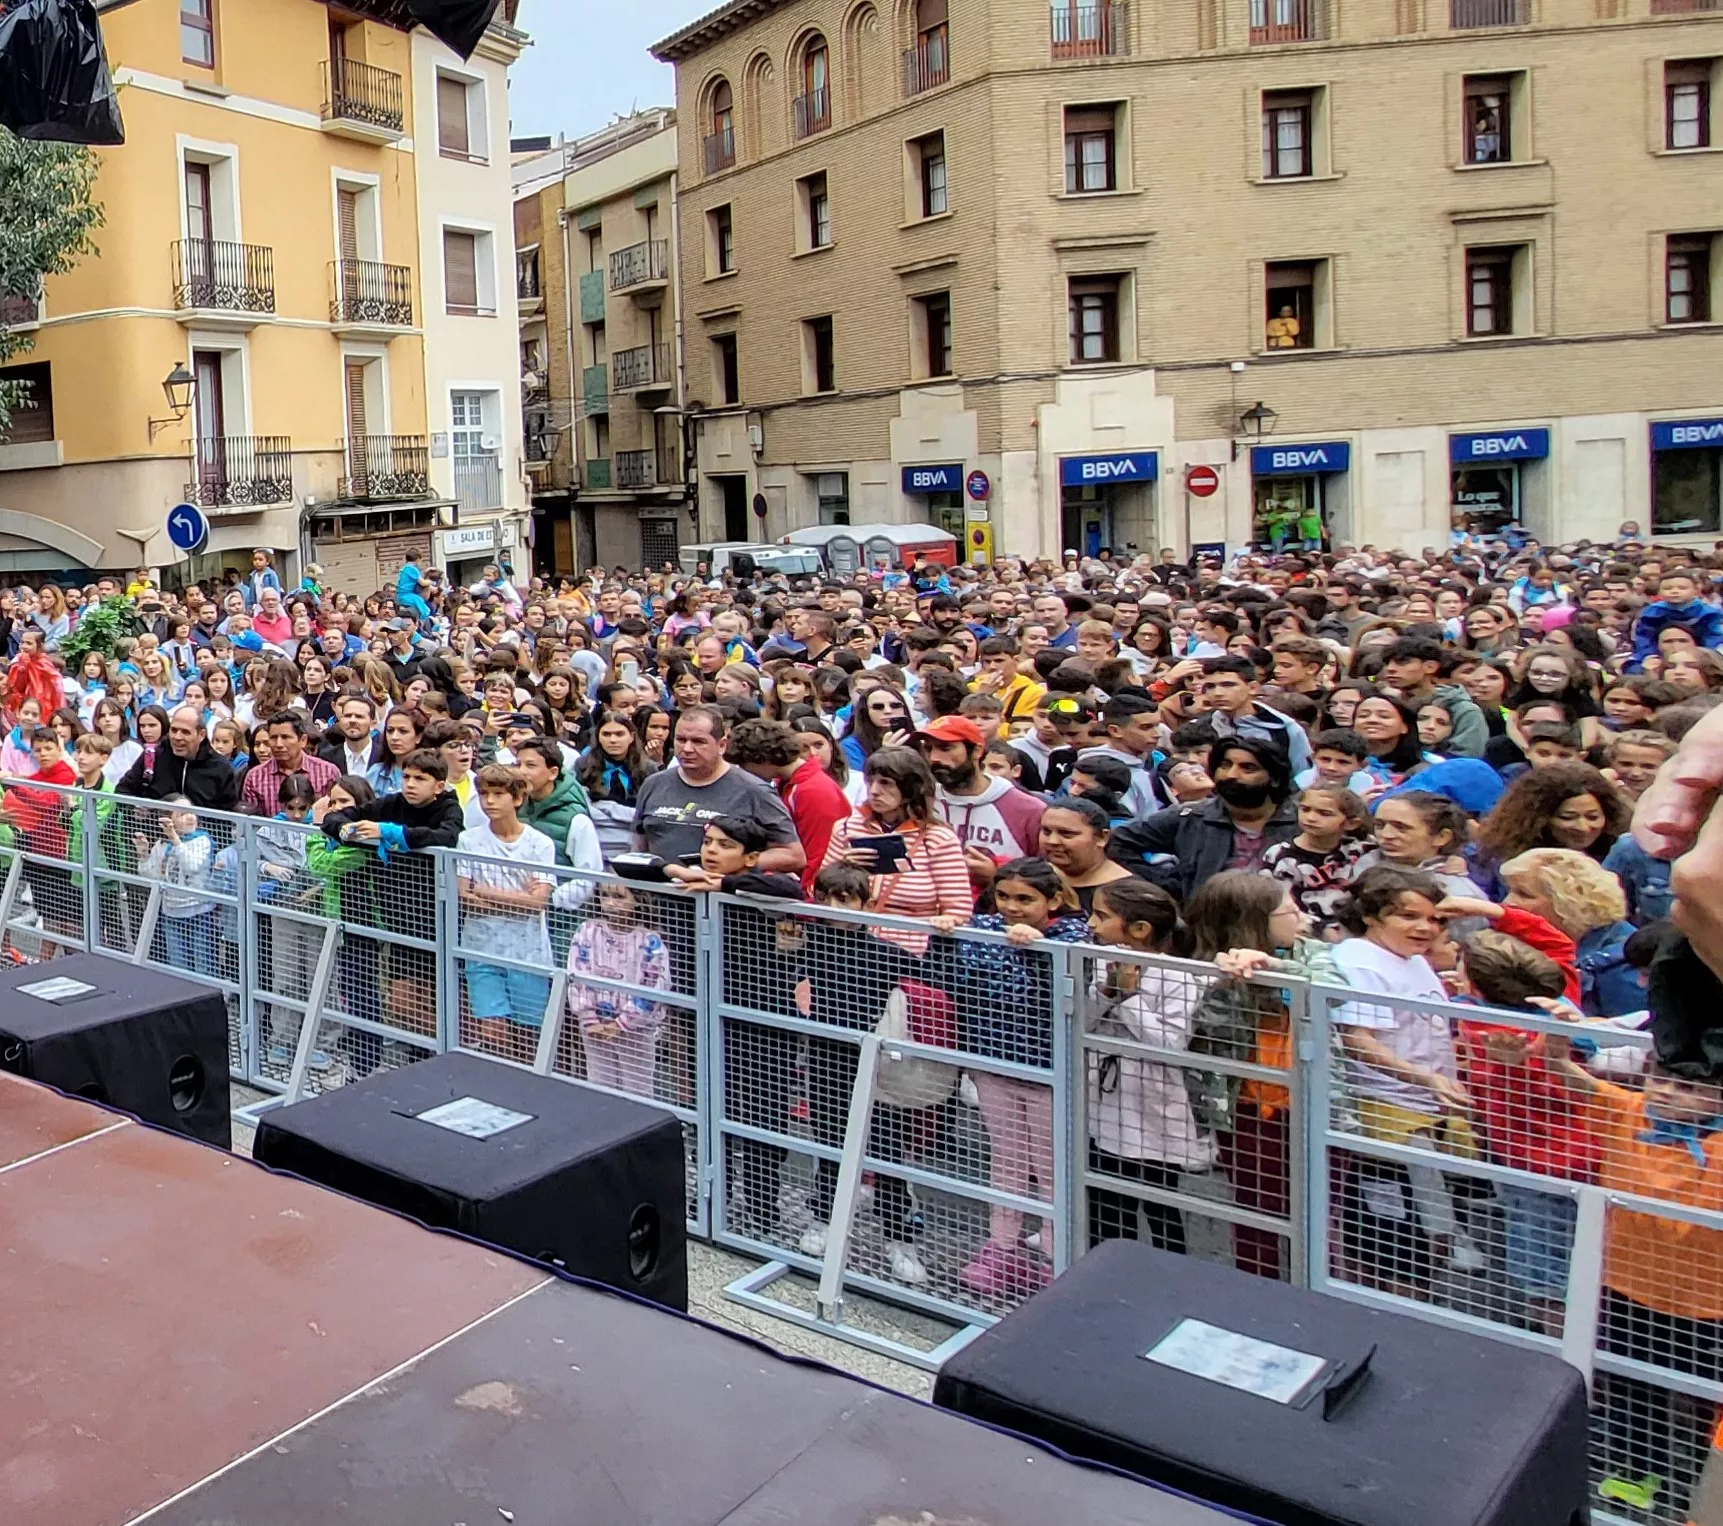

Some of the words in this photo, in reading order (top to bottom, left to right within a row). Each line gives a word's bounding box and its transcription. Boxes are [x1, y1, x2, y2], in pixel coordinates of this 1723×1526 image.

[1672, 423, 1723, 443] BBVA
[1471, 435, 1528, 455] BBVA
[1272, 449, 1328, 468] BBVA
[913, 470, 947, 486] BBVA
[1082, 459, 1137, 478] BBVA
[460, 532, 476, 543] SALA
[476, 530, 485, 541] DE
[654, 806, 683, 817] JACK
